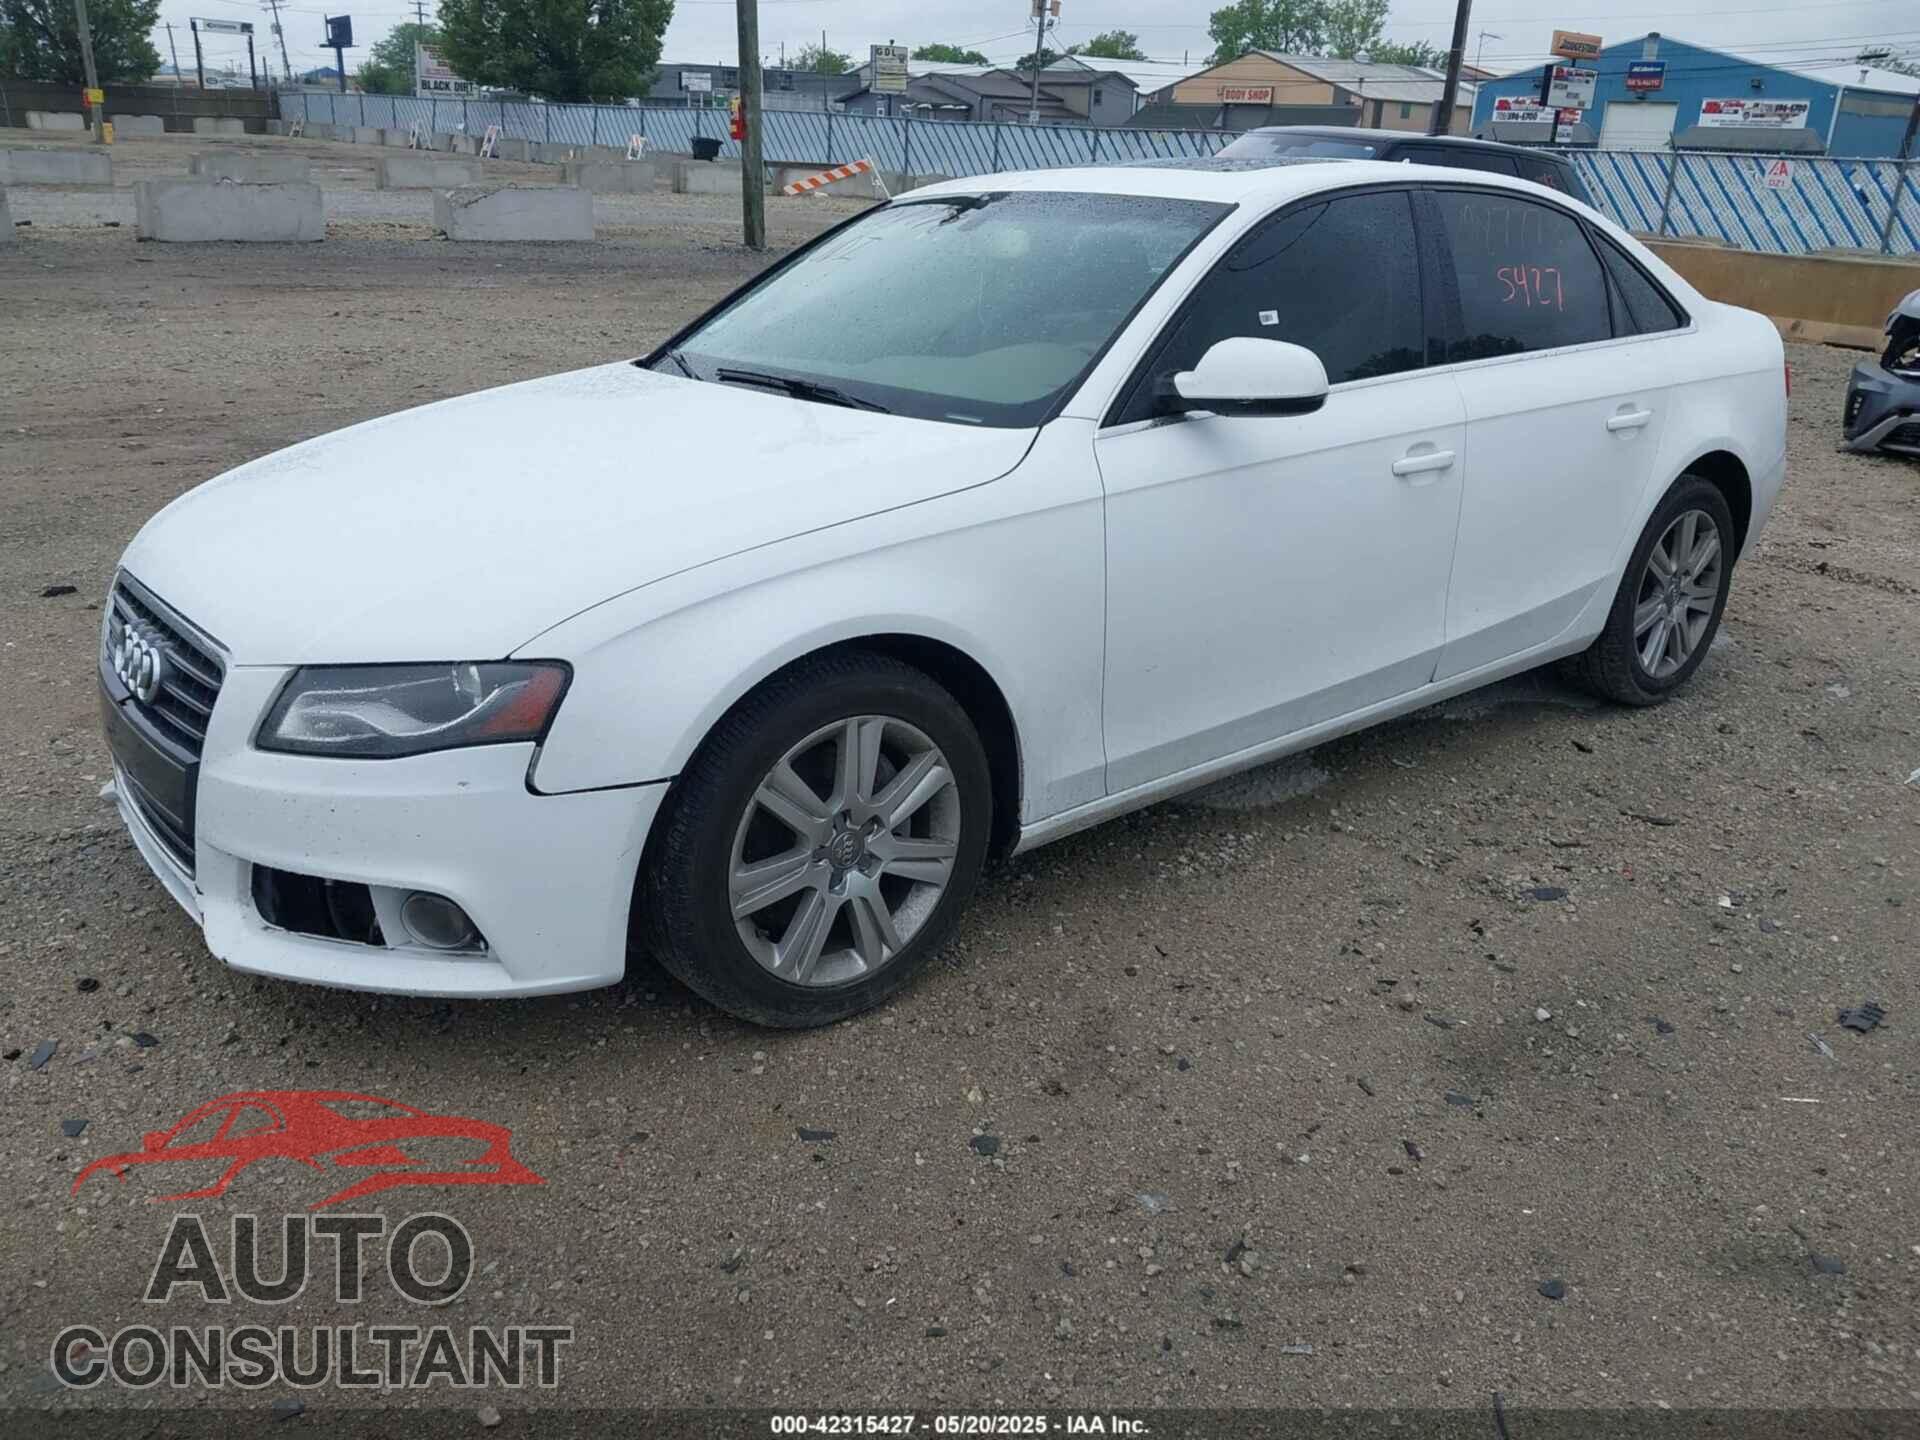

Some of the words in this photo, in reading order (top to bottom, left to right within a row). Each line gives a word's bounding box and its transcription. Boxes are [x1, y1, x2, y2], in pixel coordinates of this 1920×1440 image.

[421, 79, 450, 91] BLACK
[454, 81, 474, 92] DIRT
[1225, 89, 1246, 100] BODY
[1247, 90, 1270, 101] SHOP
